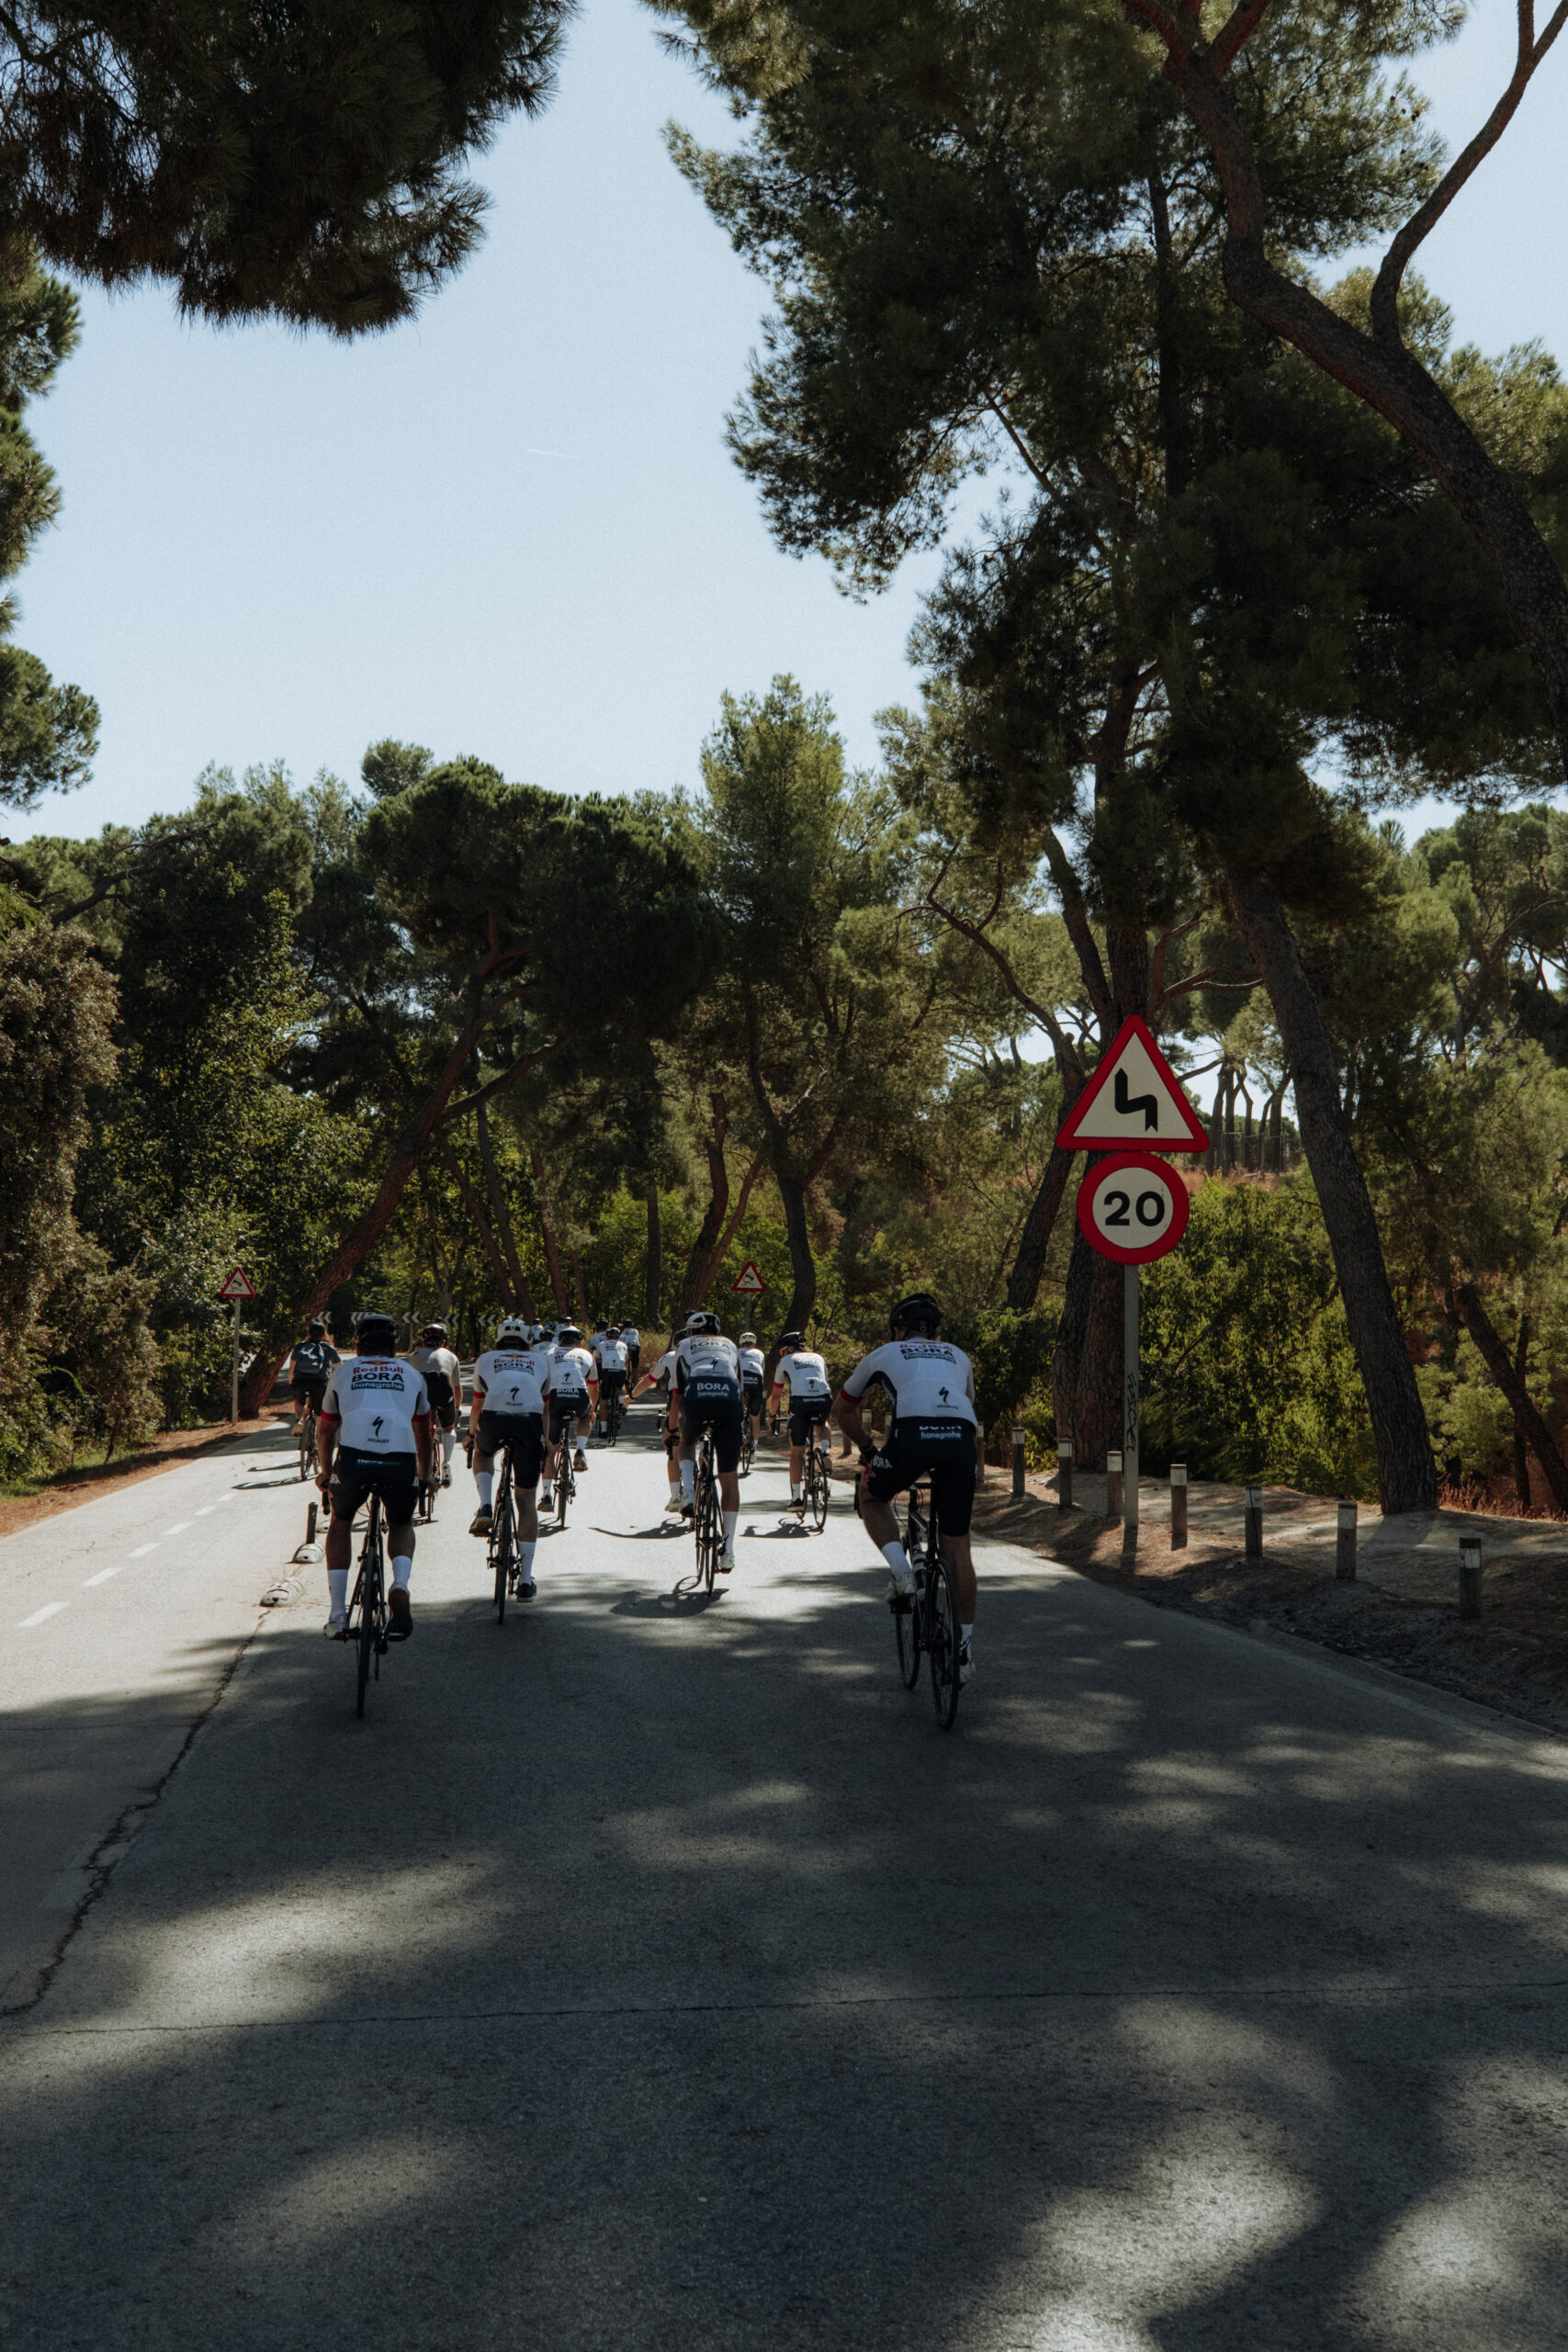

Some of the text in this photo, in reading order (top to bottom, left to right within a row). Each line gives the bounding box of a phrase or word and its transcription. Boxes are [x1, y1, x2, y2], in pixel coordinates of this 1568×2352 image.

[1104, 1191, 1166, 1227] 20
[901, 1348, 954, 1360] BORA
[353, 1366, 403, 1374] Red Bull
[494, 1363, 534, 1372] BORA
[352, 1373, 404, 1383] BORA
[353, 1382, 404, 1391] hansgrohe
[697, 1383, 729, 1391] BORA
[920, 1430, 962, 1440] hansgrohe
[873, 1455, 893, 1469] BORA
